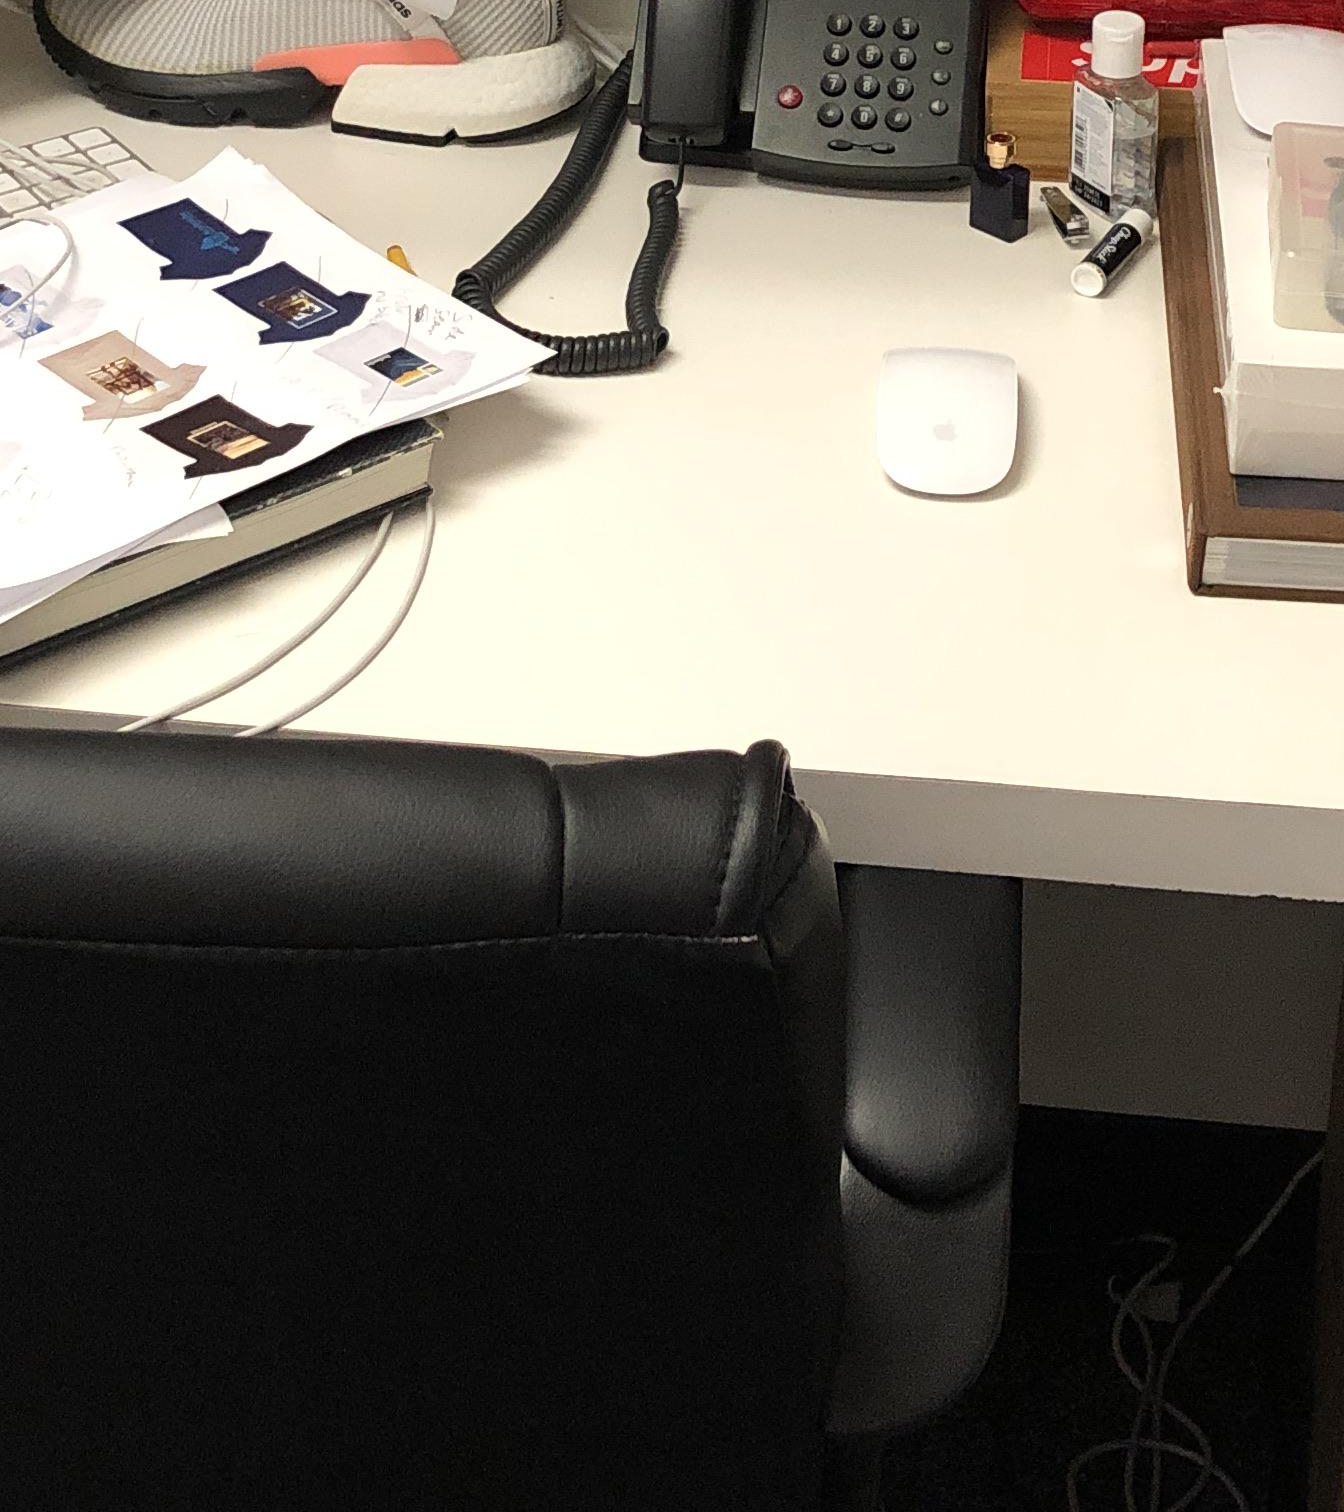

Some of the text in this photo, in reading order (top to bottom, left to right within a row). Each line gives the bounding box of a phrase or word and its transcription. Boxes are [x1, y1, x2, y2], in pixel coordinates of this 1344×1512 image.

[837, 20, 909, 34] 1 2 3
[832, 49, 907, 64] 4 5 6
[829, 79, 904, 95] 7 8 9
[860, 111, 868, 122] 0
